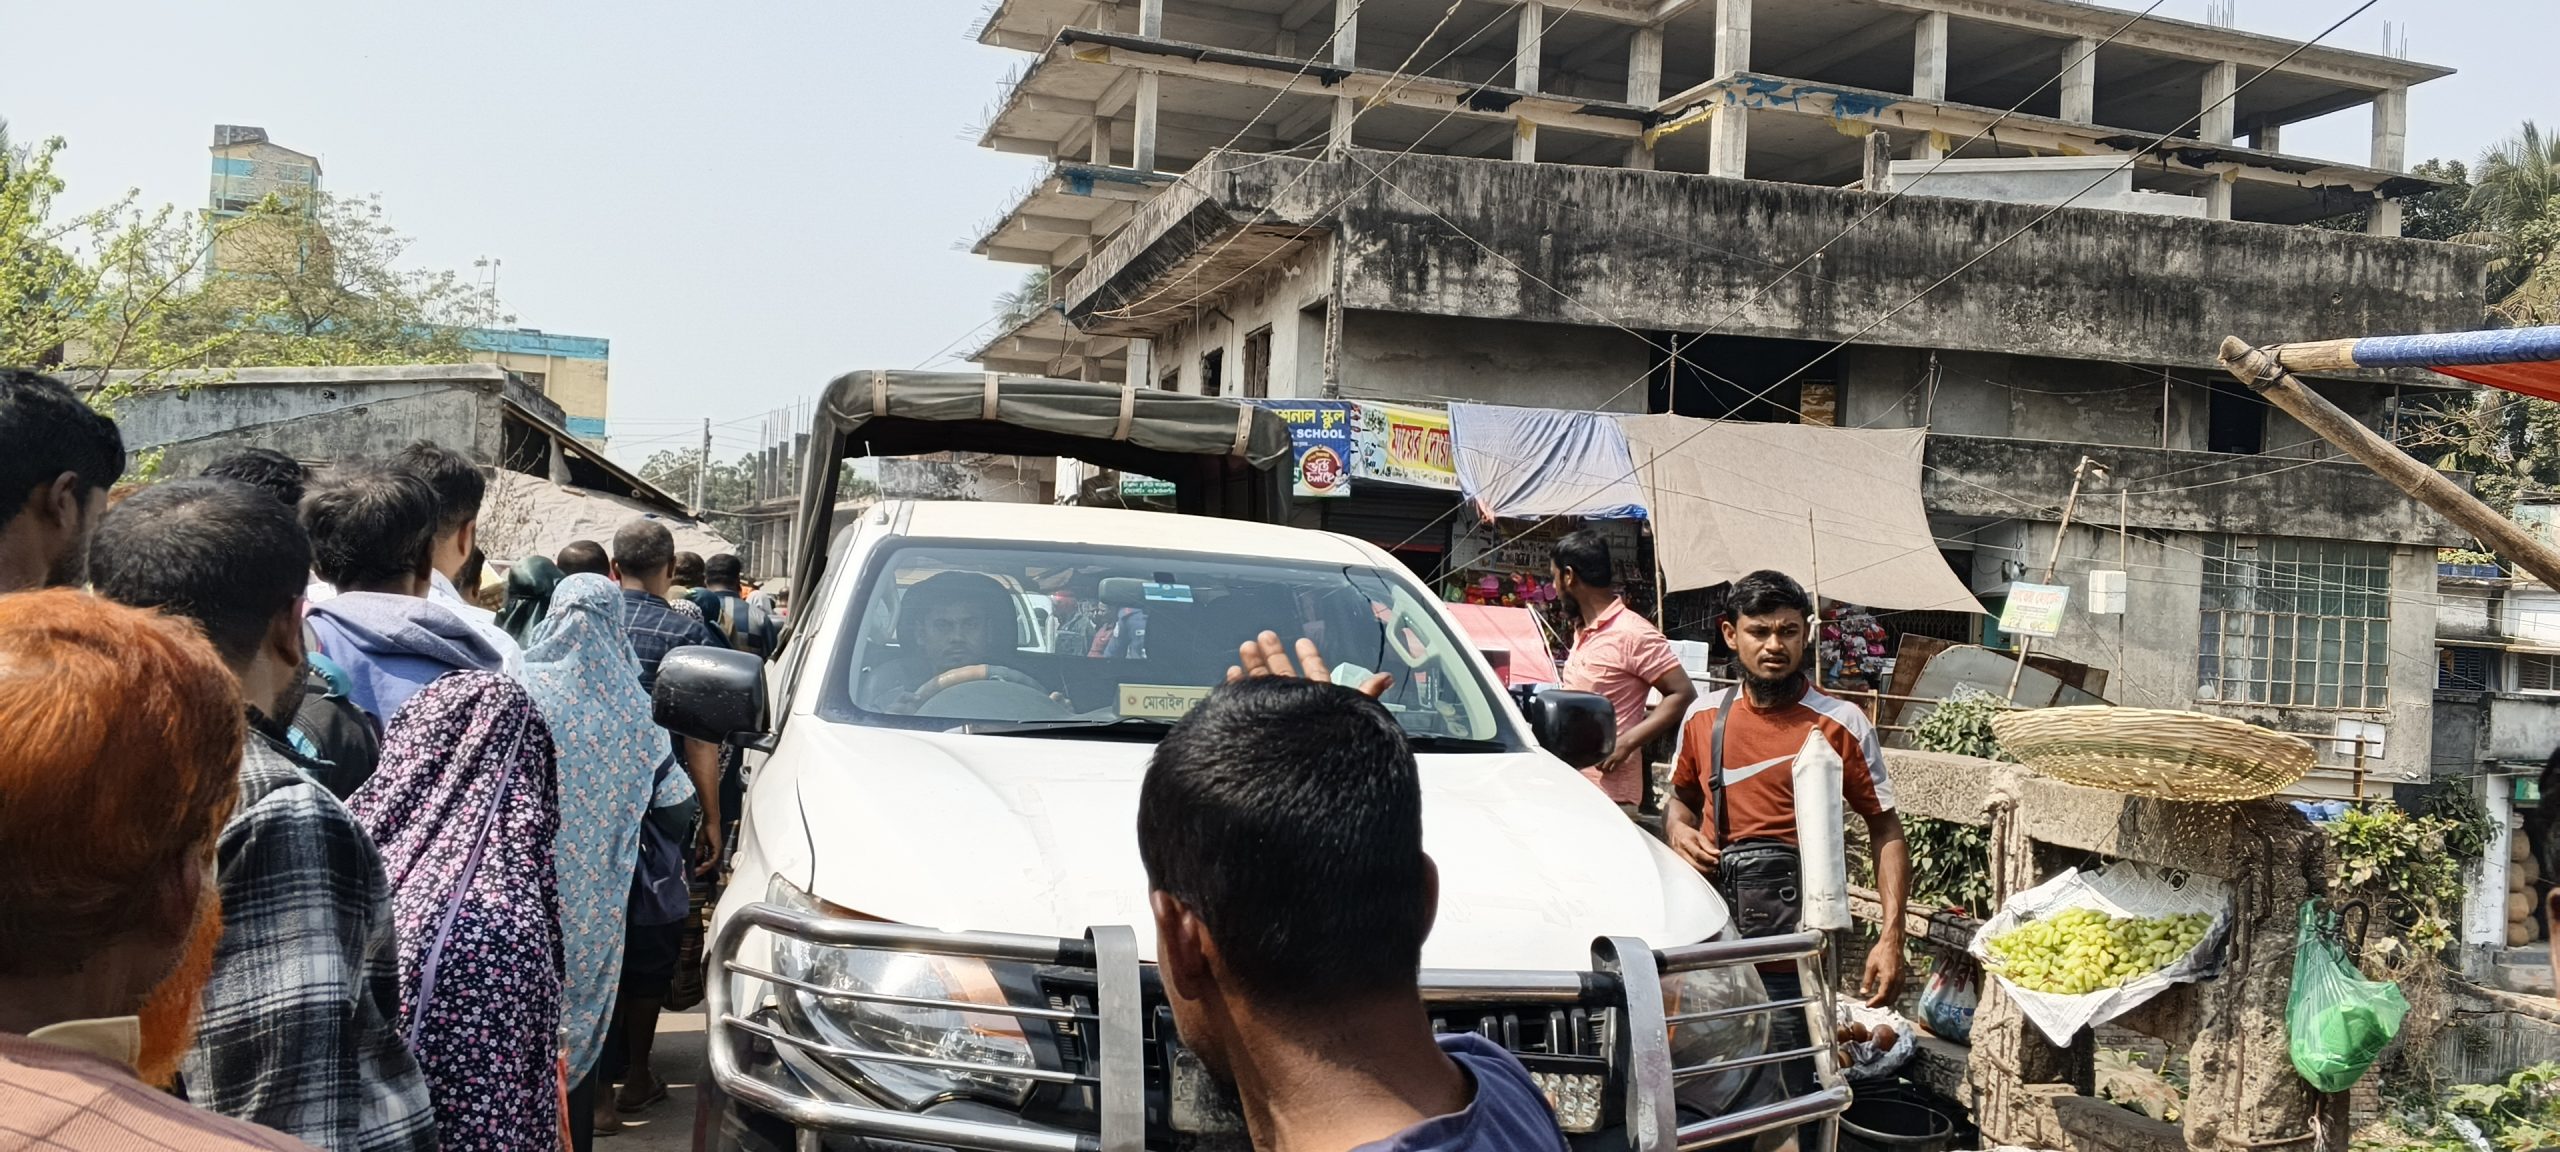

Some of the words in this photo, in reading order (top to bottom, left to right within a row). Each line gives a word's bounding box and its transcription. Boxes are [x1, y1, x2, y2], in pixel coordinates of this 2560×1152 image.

[1320, 409, 1346, 430] স্কুল
[1296, 428, 1346, 439] SCHOOL
[1142, 692, 1184, 711] মোবাইল
